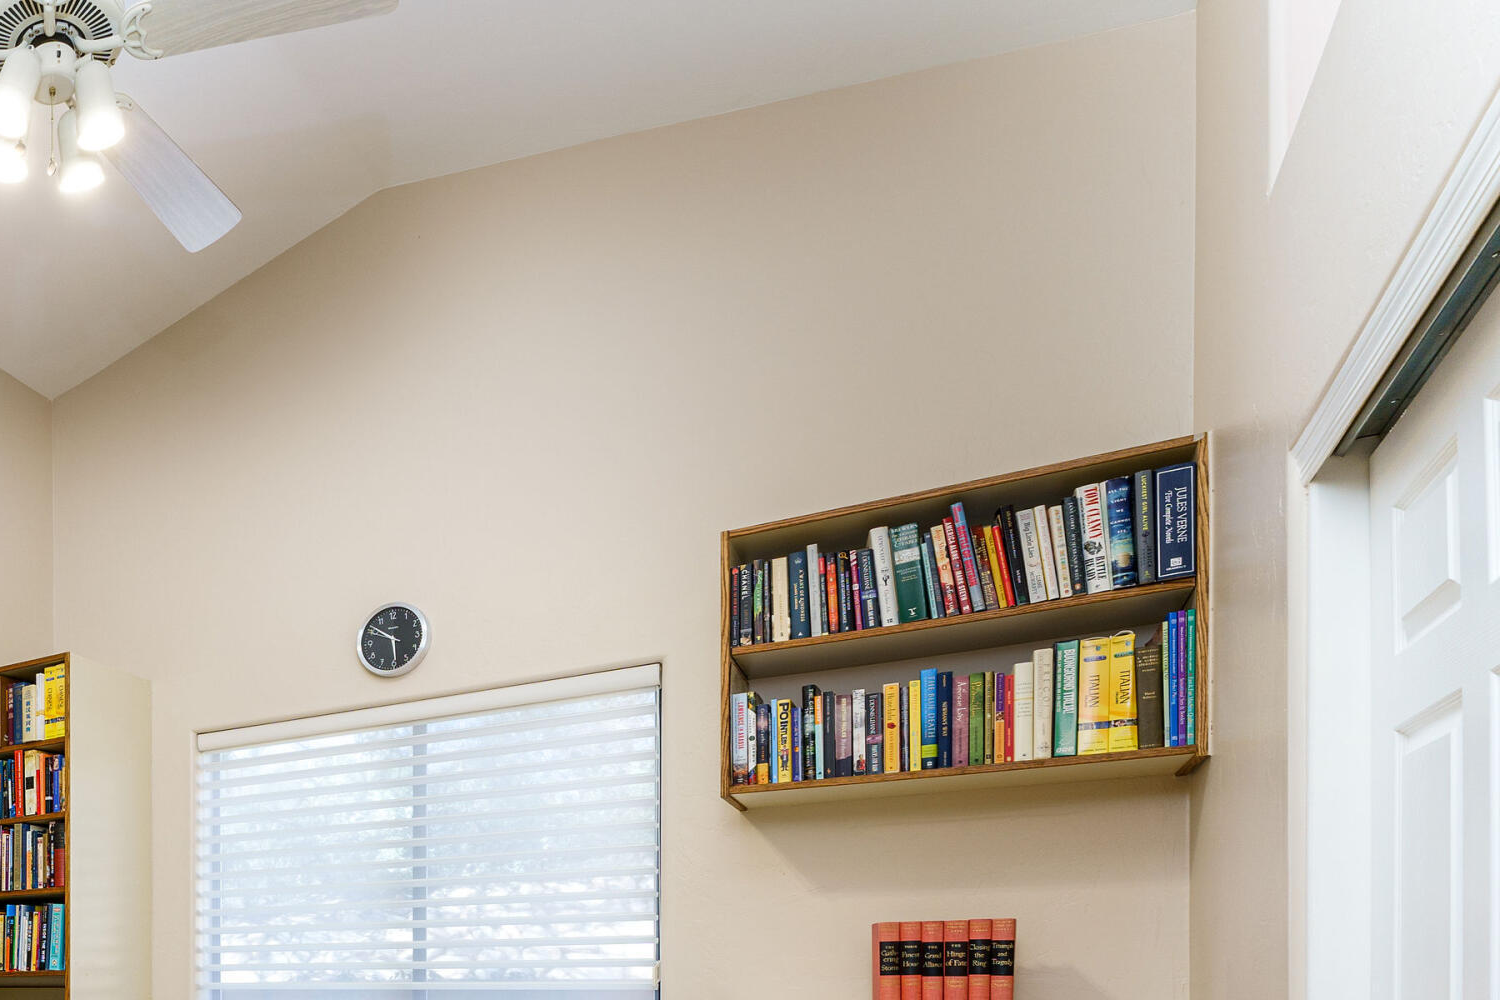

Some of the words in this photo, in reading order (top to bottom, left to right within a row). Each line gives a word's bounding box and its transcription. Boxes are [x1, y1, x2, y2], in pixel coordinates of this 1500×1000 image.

[1084, 486, 1100, 506] TOM
[1175, 487, 1187, 512] JULES
[1087, 508, 1103, 539] CLANCY
[1163, 504, 1173, 525] Complete
[1165, 526, 1174, 544] Novels
[1177, 512, 1187, 543] VERNE
[945, 522, 955, 544] AMERICA
[950, 545, 959, 560] ALONE
[1085, 559, 1096, 581] READY
[1096, 556, 1107, 580] BATTLE
[959, 586, 967, 601] STEYN
[1063, 649, 1076, 690] BUONGIORNO
[1089, 675, 1100, 708] ITALIAN
[1119, 670, 1131, 704] ITALIAN
[1063, 692, 1075, 714] ITALIA!
[779, 702, 790, 745] POINTLESS
[972, 959, 987, 968] Ring
